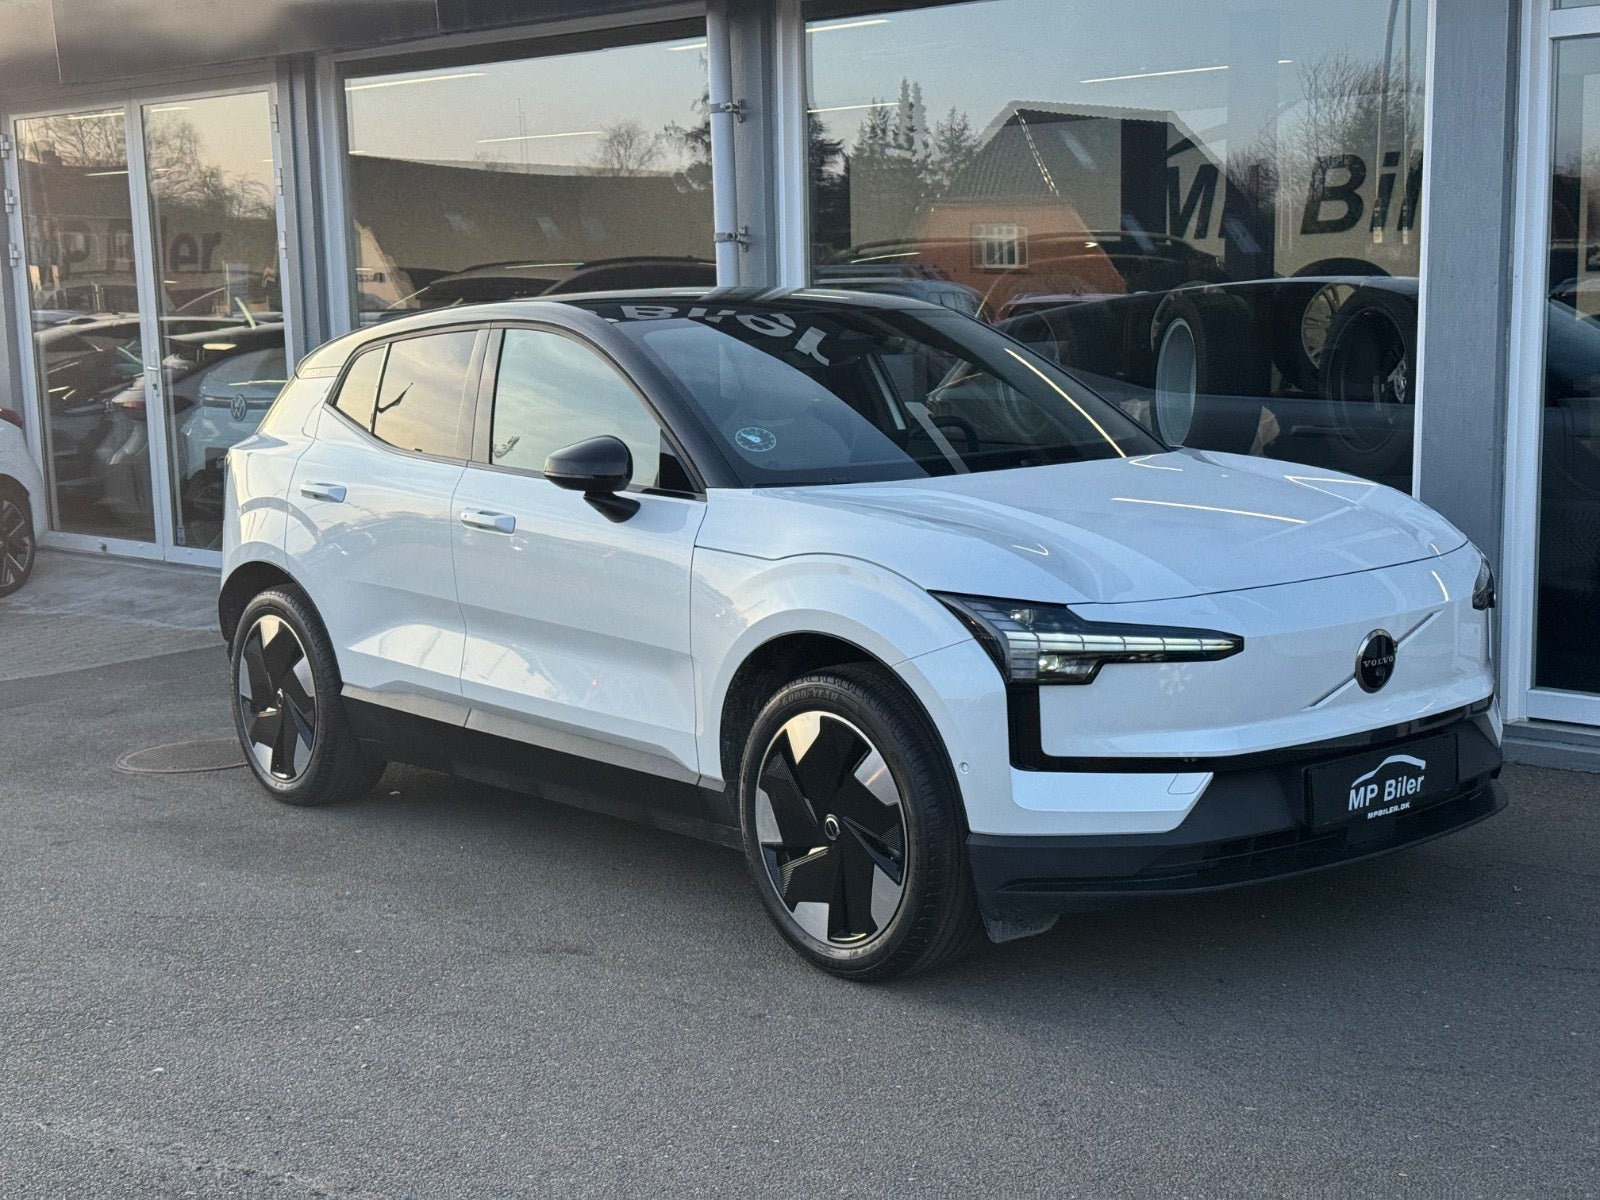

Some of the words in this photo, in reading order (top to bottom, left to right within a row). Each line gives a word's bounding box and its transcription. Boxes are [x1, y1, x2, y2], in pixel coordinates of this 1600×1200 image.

[1362, 655, 1394, 667] VOLVO
[1348, 784, 1379, 811] MP
[1384, 775, 1425, 801] Biler
[1367, 802, 1410, 819] MPBILER.DK
